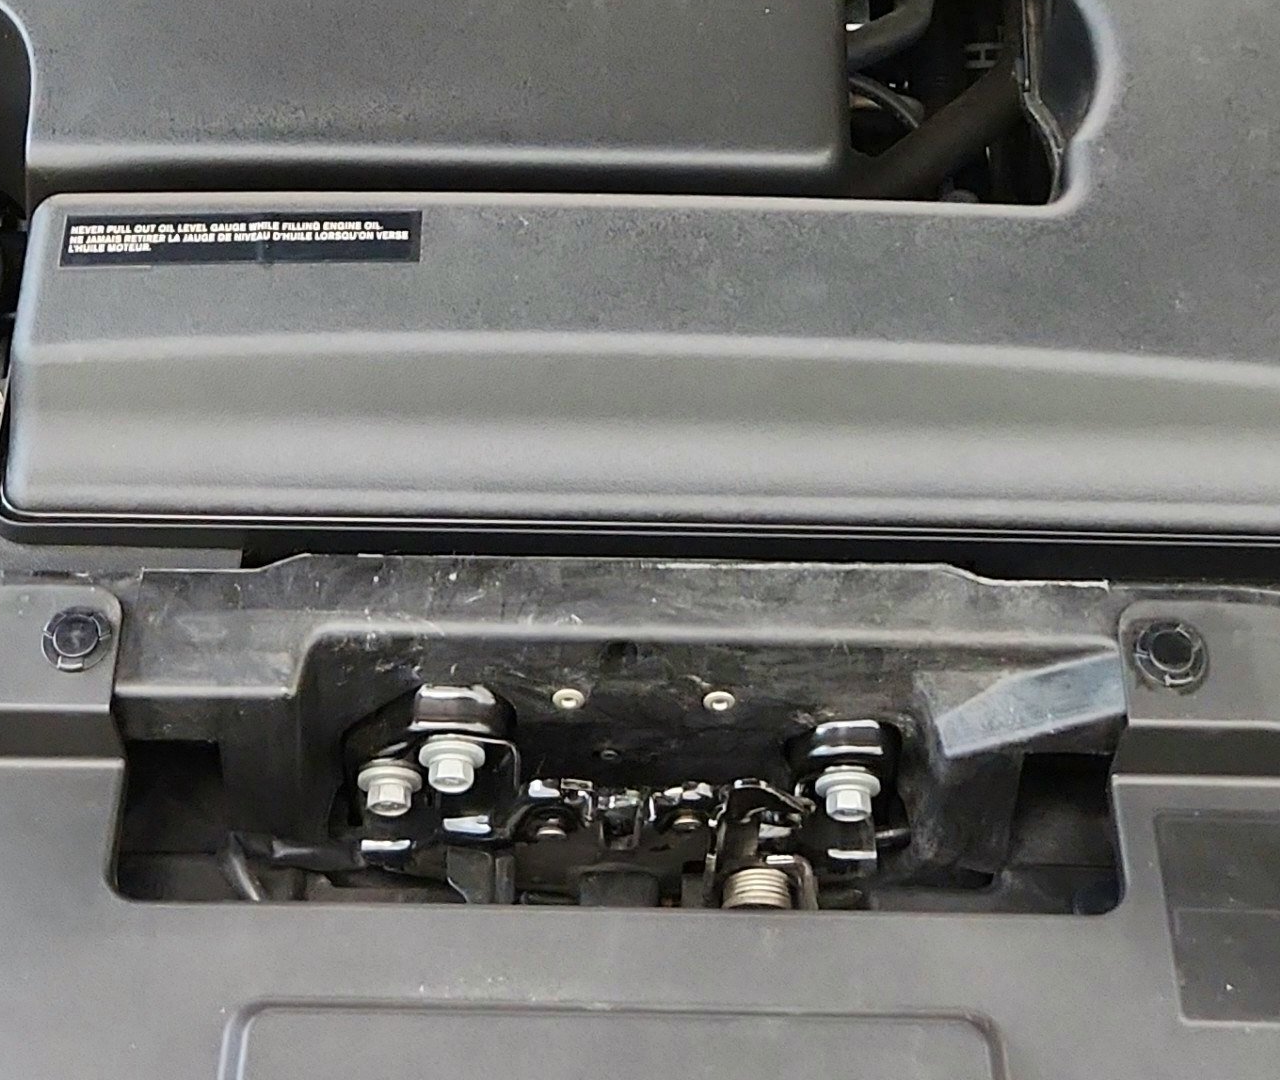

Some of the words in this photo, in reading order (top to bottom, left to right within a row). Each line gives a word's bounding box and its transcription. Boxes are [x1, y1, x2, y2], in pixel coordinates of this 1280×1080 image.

[71, 225, 106, 234] NEVER
[106, 225, 132, 234] PULL
[134, 224, 156, 233] OUT
[158, 224, 175, 233] OIL
[178, 223, 208, 232] LEVEL
[210, 222, 246, 232] GAUGE
[249, 221, 279, 231] WHILE
[282, 221, 320, 230] FILLING
[323, 221, 361, 230] ENGINE
[364, 221, 384, 230] OIL.
[69, 234, 84, 244] NE
[86, 234, 122, 244] JAMAIS
[124, 234, 166, 243] RETIRER
[168, 233, 181, 243] LA
[183, 233, 215, 242] JAUGE
[217, 232, 232, 242] DE
[234, 231, 271, 241] NIVEAU
[272, 231, 313, 241] D'HUILE
[315, 231, 374, 241] LORSQU'ON
[376, 230, 409, 240] VERSE
[68, 243, 105, 253] L'HUILE
[107, 243, 151, 253] MOTEUR.
